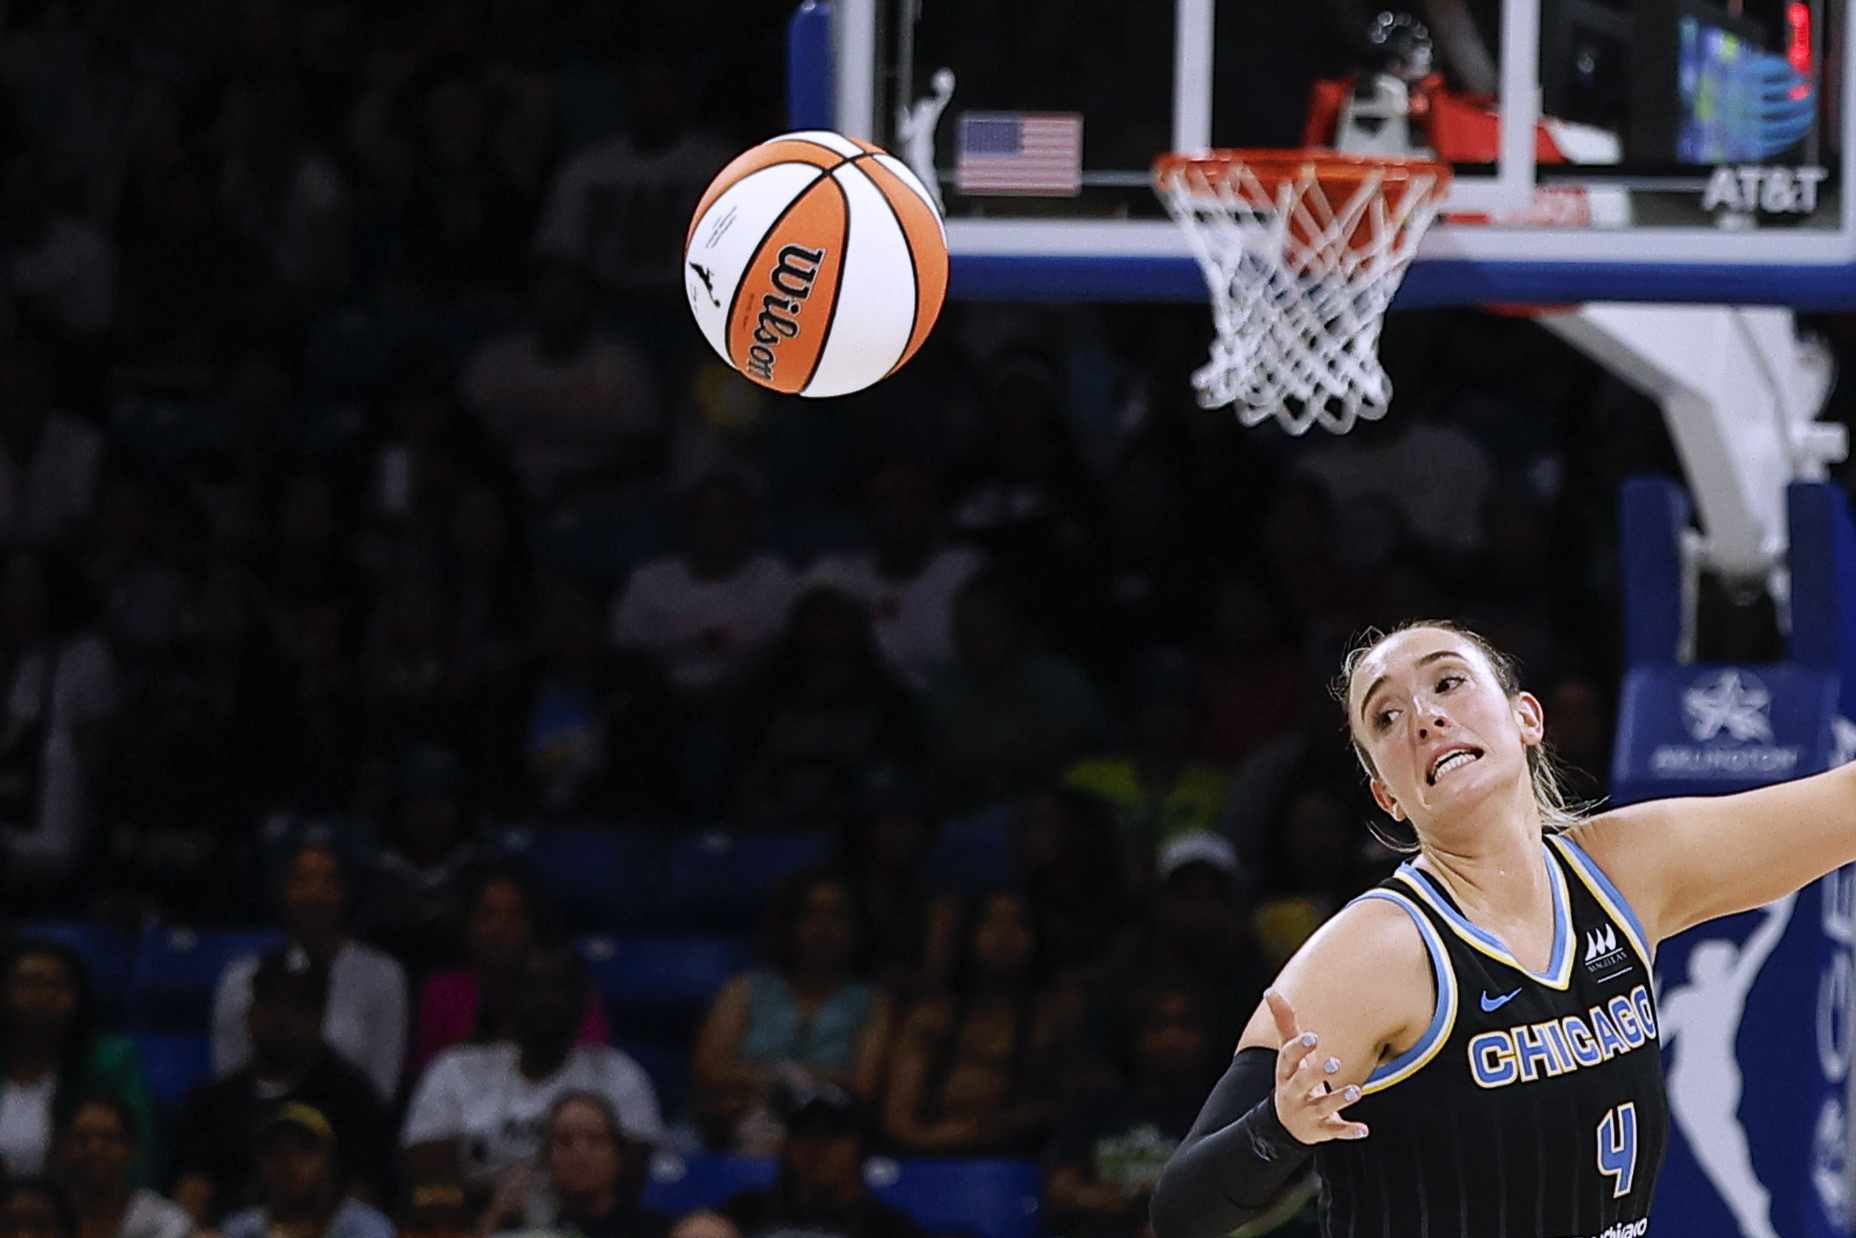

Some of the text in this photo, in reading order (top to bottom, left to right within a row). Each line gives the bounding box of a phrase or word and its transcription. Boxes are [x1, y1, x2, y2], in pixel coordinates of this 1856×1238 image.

[1702, 165, 1828, 213] AT&T
[747, 241, 826, 382] Wilson
[1467, 984, 1656, 1089] CHICAGO
[1596, 1101, 1638, 1199] 4
